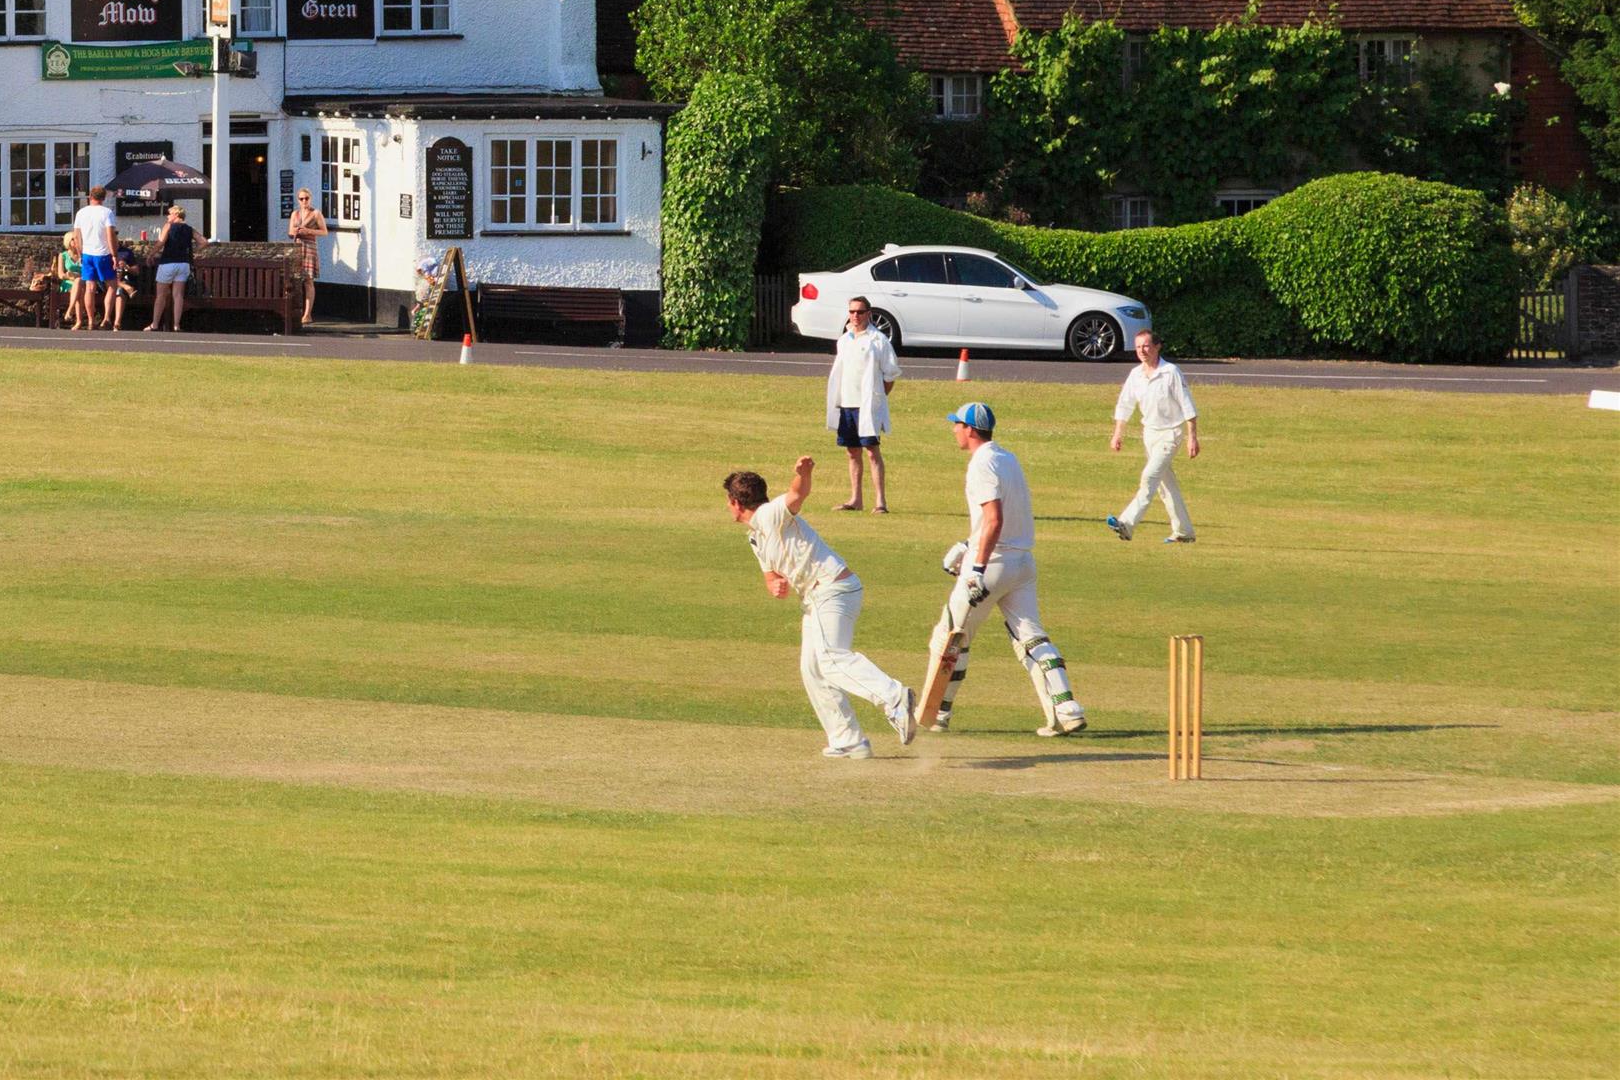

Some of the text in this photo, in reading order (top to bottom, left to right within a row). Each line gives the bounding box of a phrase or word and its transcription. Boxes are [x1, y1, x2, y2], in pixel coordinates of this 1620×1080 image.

[98, 1, 156, 26] Mow
[301, 0, 357, 18] Green
[73, 49, 87, 59] THE
[88, 49, 114, 58] BARLEY
[115, 49, 133, 58] MOW
[141, 48, 160, 58] HOGS
[161, 46, 180, 58] BACK
